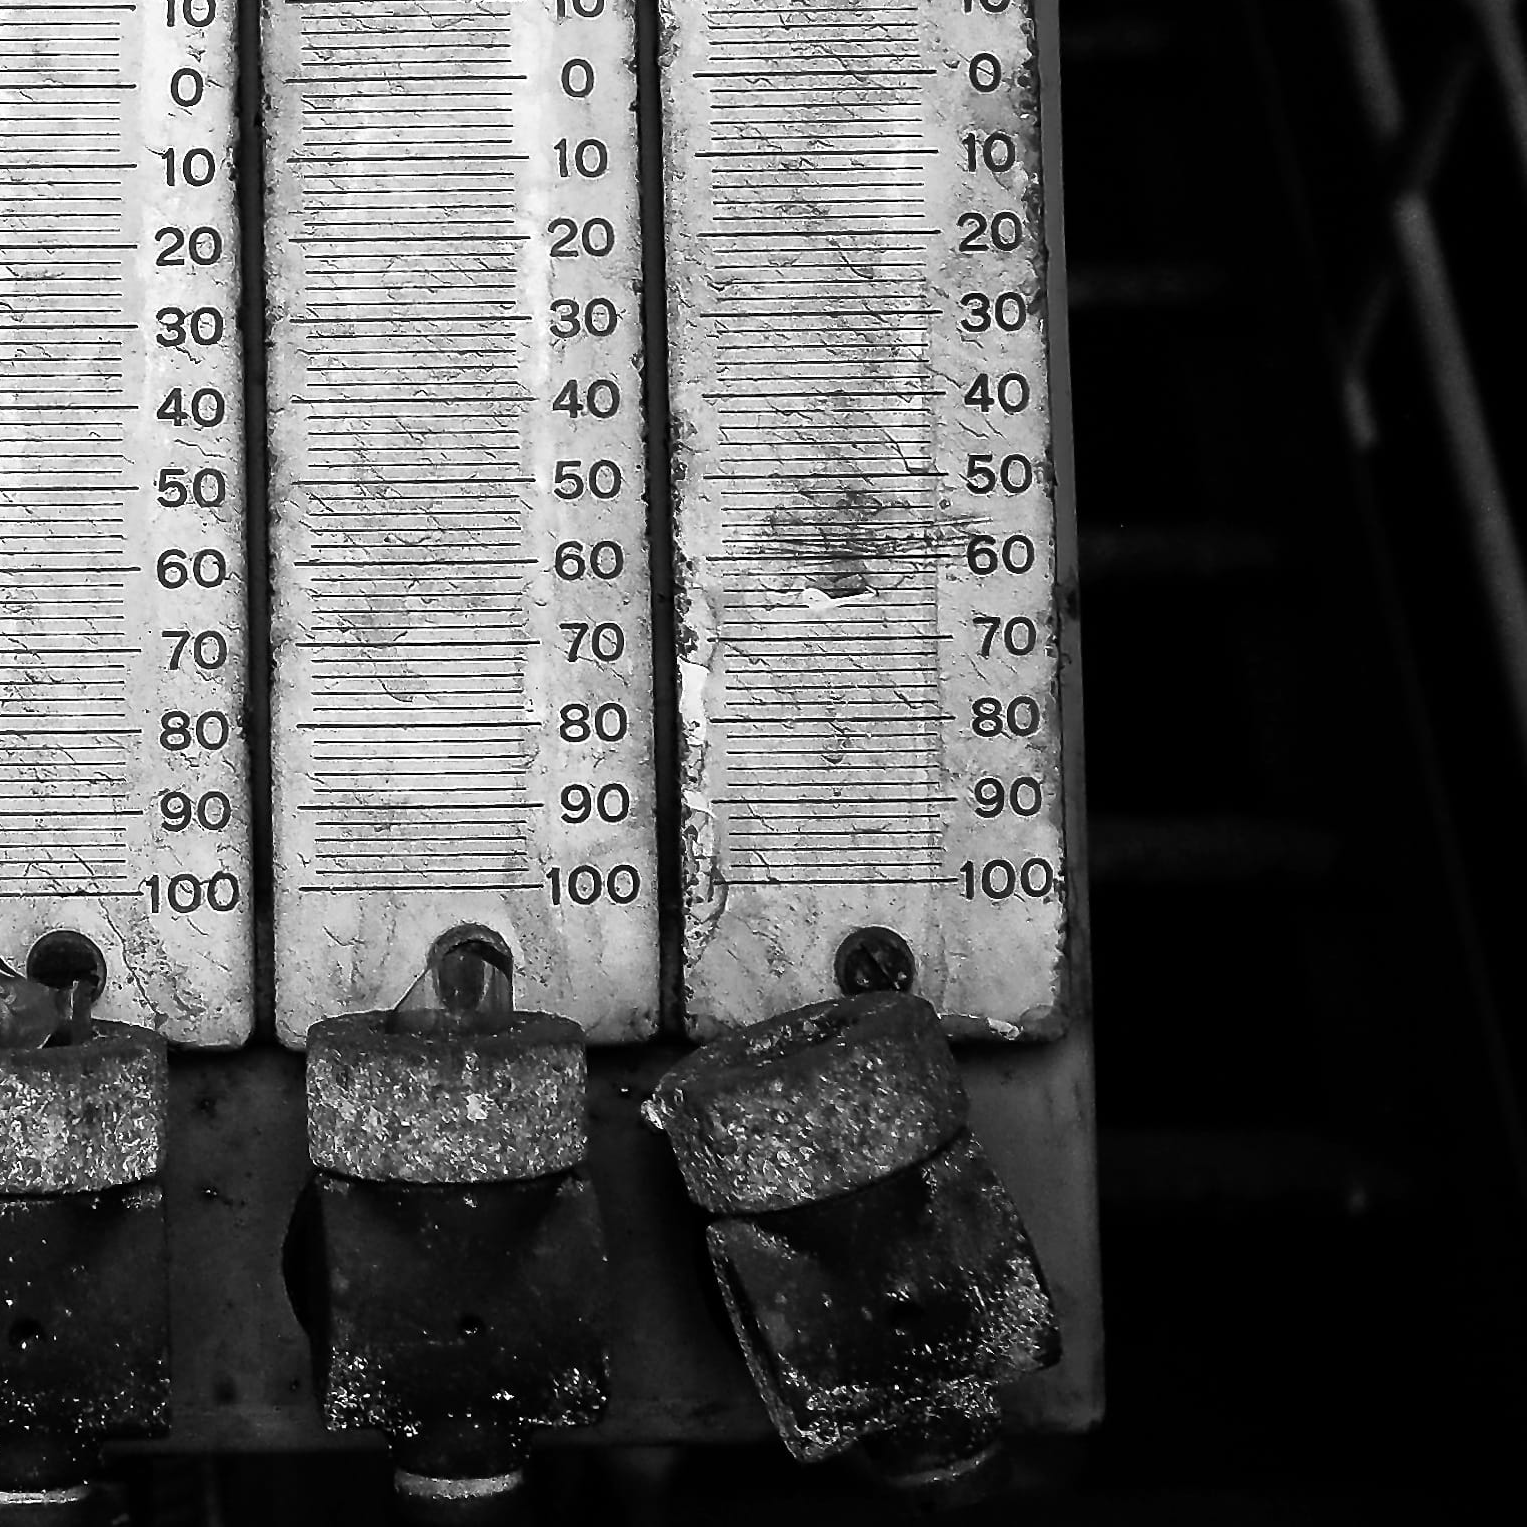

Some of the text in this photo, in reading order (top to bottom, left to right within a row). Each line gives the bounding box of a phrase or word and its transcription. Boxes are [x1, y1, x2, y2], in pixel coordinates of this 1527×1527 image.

[170, 68, 203, 107] 0
[561, 59, 594, 98] 0
[969, 53, 1001, 92] 0
[163, 148, 215, 187] 10
[554, 138, 607, 178] 10
[960, 132, 1015, 175] 10
[155, 227, 221, 266] 20
[547, 218, 614, 257] 20
[959, 213, 1024, 253] 20
[156, 308, 224, 348] 30
[550, 298, 618, 338] 30
[962, 293, 1027, 334] 30
[157, 388, 224, 428] 40
[553, 380, 619, 418] 40
[964, 373, 1029, 415] 40
[157, 468, 225, 508] 50
[554, 460, 622, 500] 50
[967, 454, 1032, 495] 50
[159, 549, 226, 590] 60
[554, 541, 623, 581] 60
[969, 535, 1035, 576] 60
[162, 631, 227, 670] 70
[559, 623, 624, 662] 70
[971, 615, 1037, 657] 70
[159, 710, 226, 751] 80
[560, 703, 627, 742] 80
[972, 696, 1039, 737] 80
[159, 790, 231, 831] 90
[561, 783, 629, 824] 90
[974, 777, 1041, 818] 90
[143, 872, 240, 914] 100
[546, 865, 639, 905] 100
[960, 859, 1052, 900] 100
